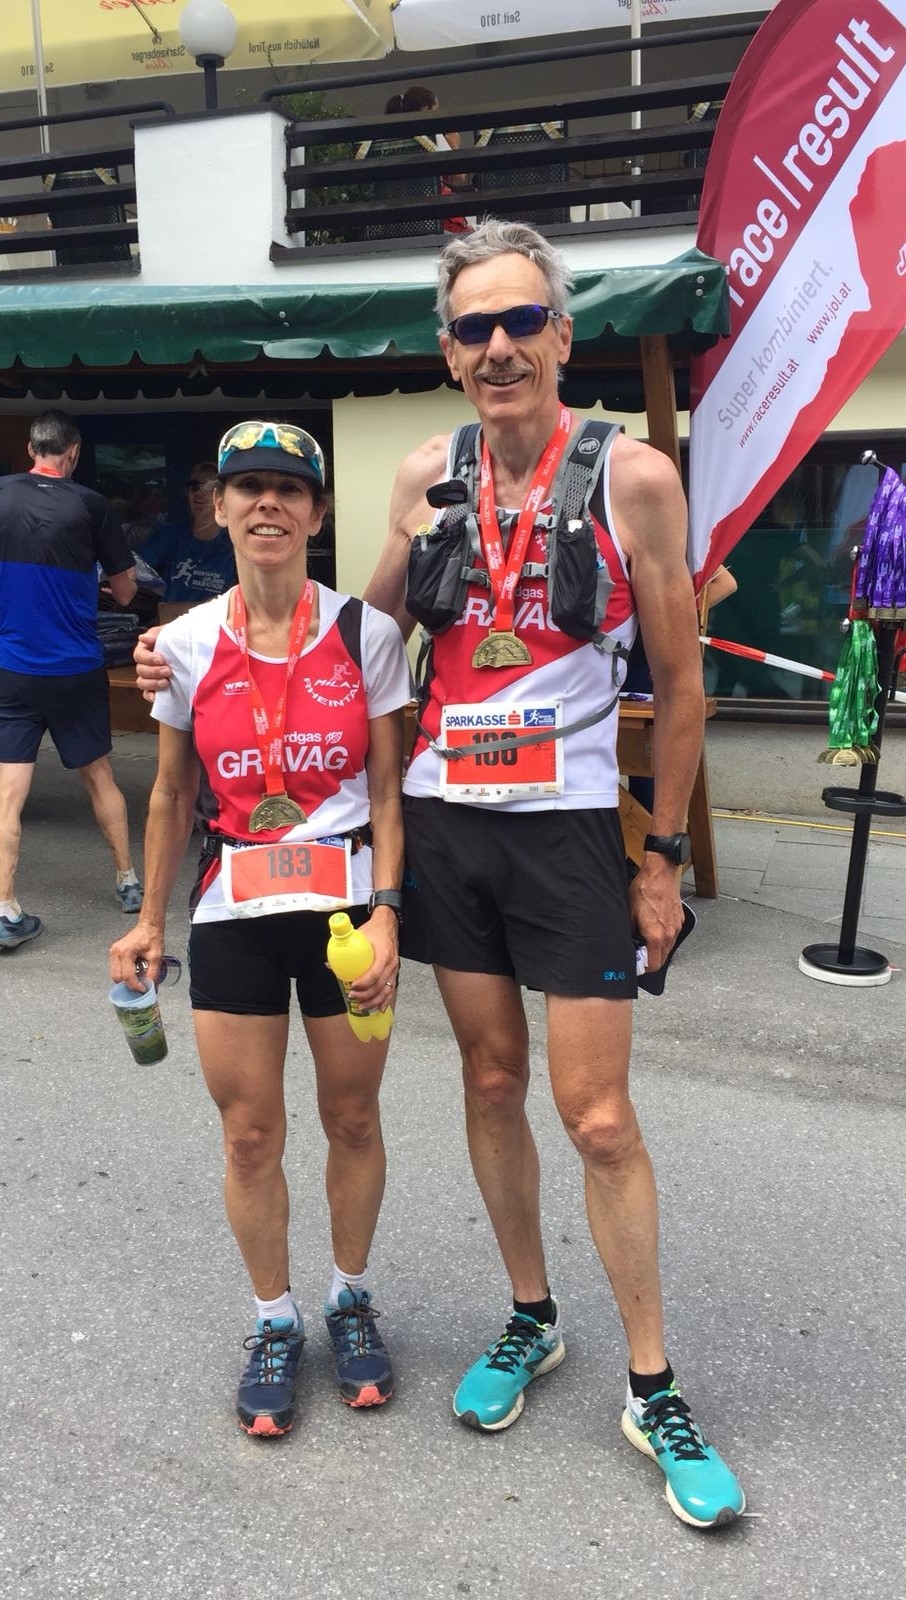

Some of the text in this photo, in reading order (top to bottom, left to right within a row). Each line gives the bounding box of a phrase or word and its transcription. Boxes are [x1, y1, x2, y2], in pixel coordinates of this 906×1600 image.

[806, 281, 852, 345] www.jol.at
[717, 259, 834, 431] Super kombiniert.
[738, 357, 800, 448] www.raceresult.at
[303, 677, 361, 707] RHEINTAL
[445, 714, 507, 727] SPARKASSE
[284, 731, 322, 744] rdgas
[217, 746, 349, 779] GRVAG
[266, 847, 312, 879] 183
